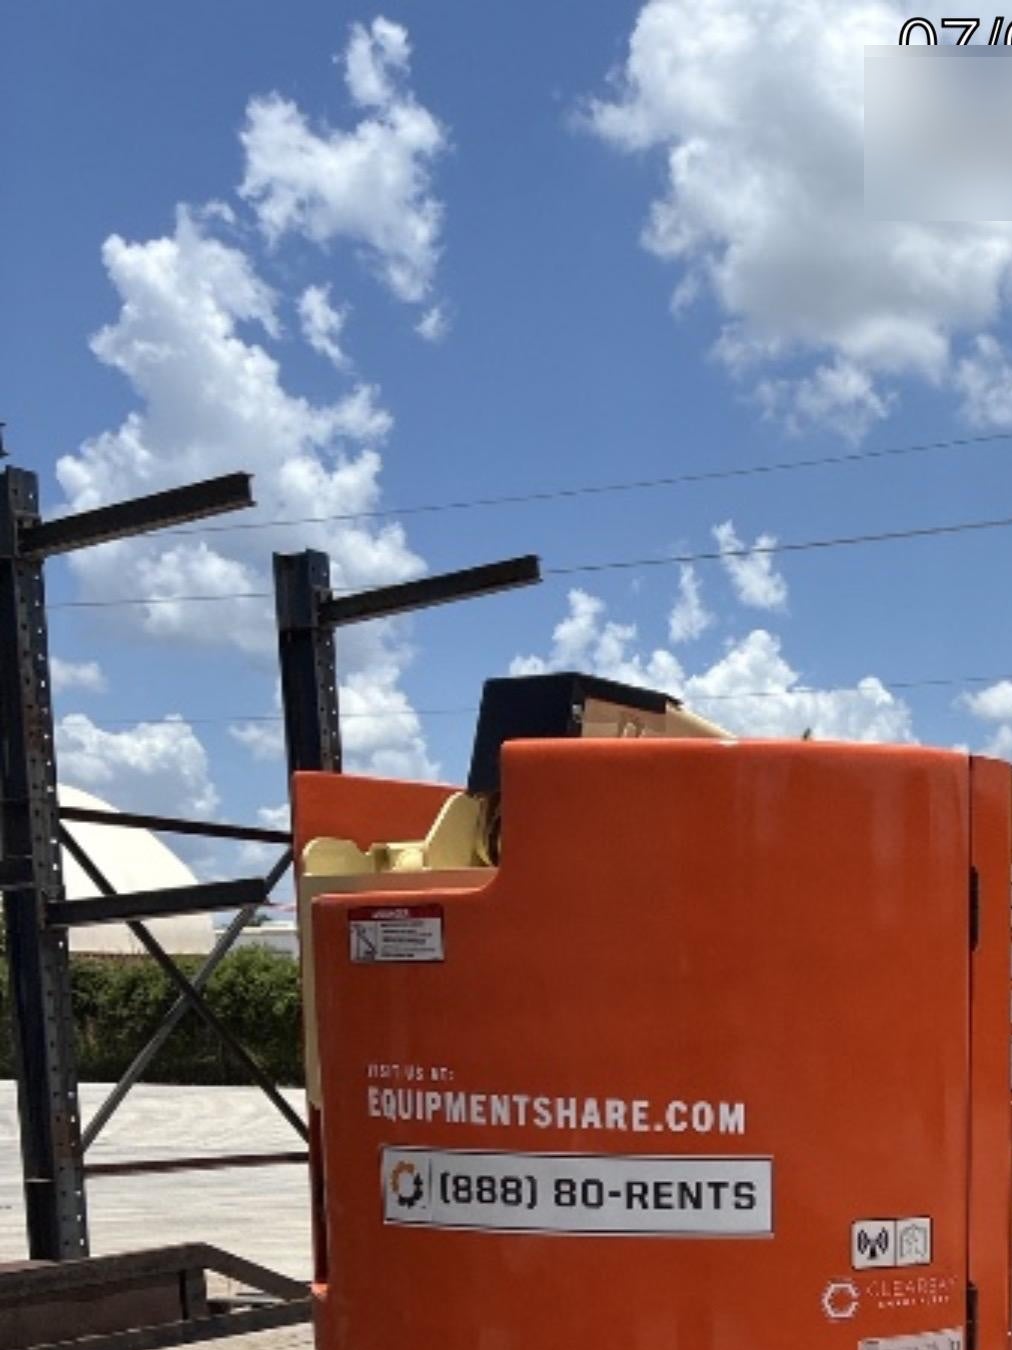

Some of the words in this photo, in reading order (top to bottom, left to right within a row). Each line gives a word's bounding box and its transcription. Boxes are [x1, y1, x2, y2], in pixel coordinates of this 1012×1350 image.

[404, 1064, 424, 1081] US
[367, 1086, 746, 1135] EQUIPMENTSHARE.COM
[439, 1171, 539, 1210] (888)
[553, 1178, 757, 1210] 80-RENTS
